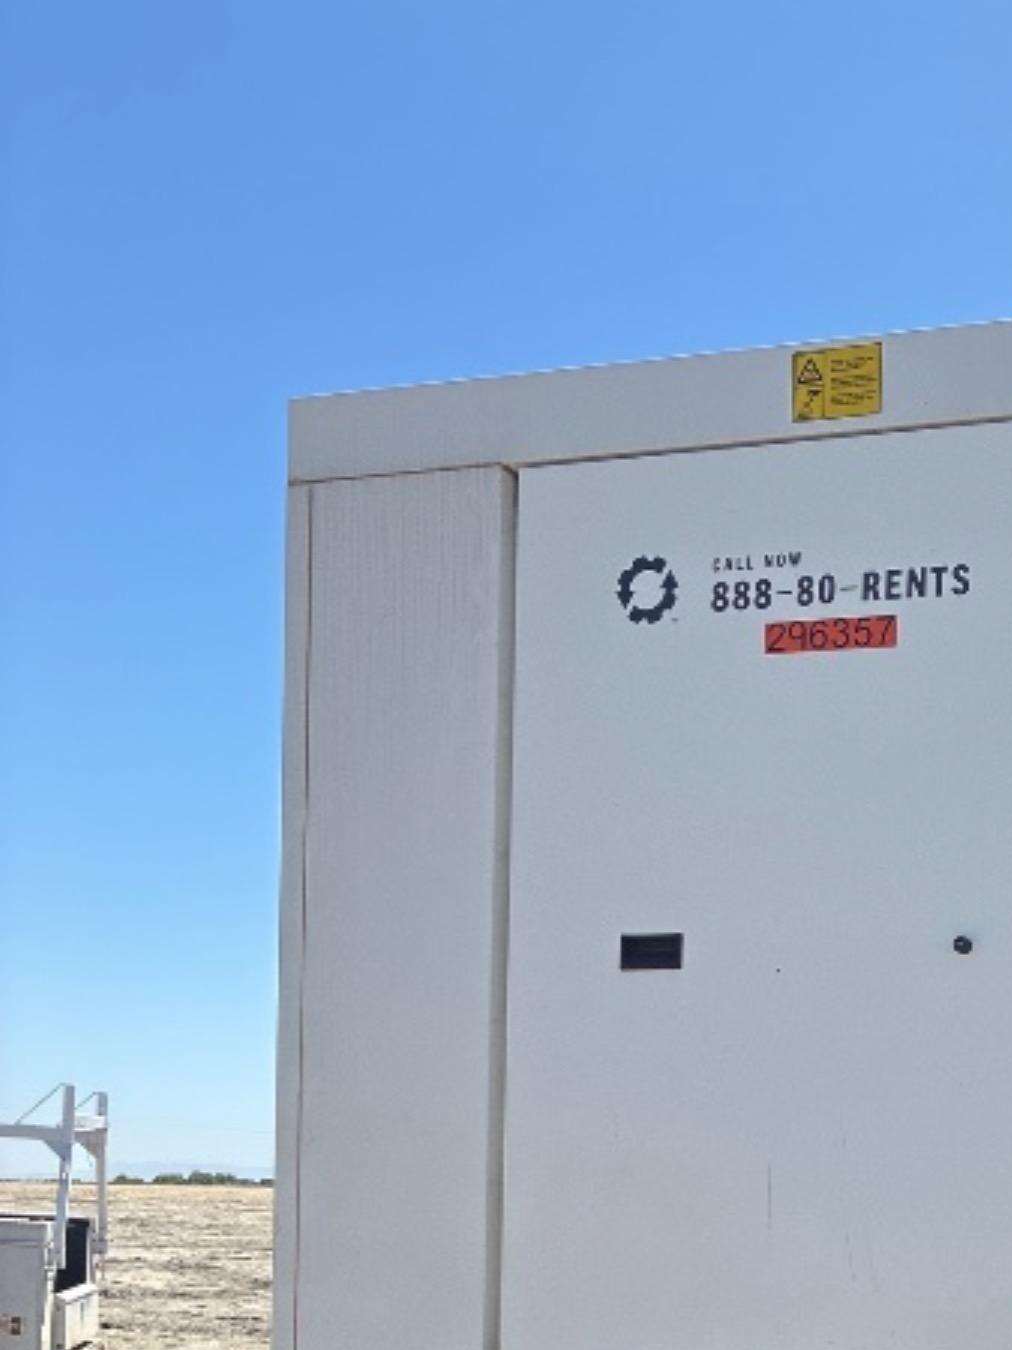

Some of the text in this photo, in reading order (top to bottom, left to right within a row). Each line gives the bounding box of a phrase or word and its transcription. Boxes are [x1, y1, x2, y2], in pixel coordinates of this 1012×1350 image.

[712, 551, 802, 573] CALL NOW
[710, 563, 970, 612] 888-80-RENTS
[767, 616, 896, 652] 296357
